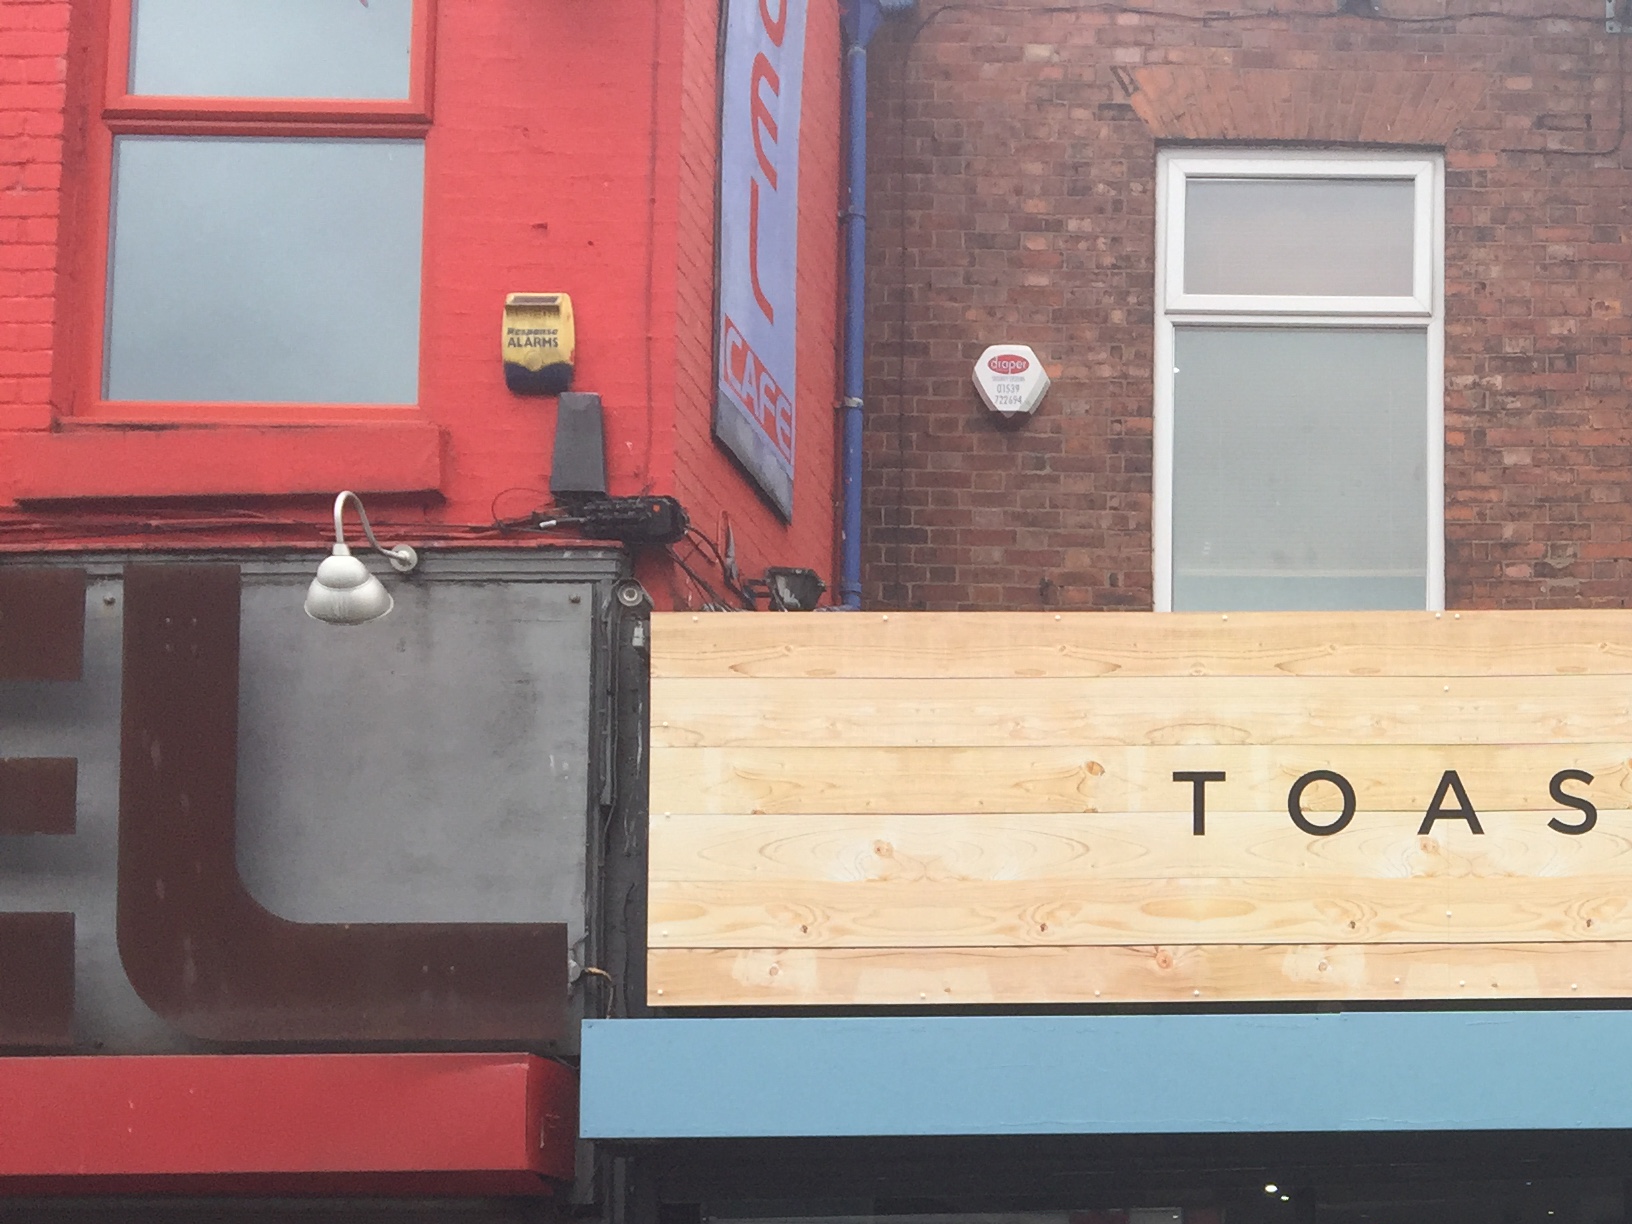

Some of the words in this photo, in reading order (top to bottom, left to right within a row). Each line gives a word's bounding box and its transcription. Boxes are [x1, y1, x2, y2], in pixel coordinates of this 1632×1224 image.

[507, 337, 559, 348] ALARMS
[990, 355, 1027, 375] draper
[996, 384, 1020, 394] 01539
